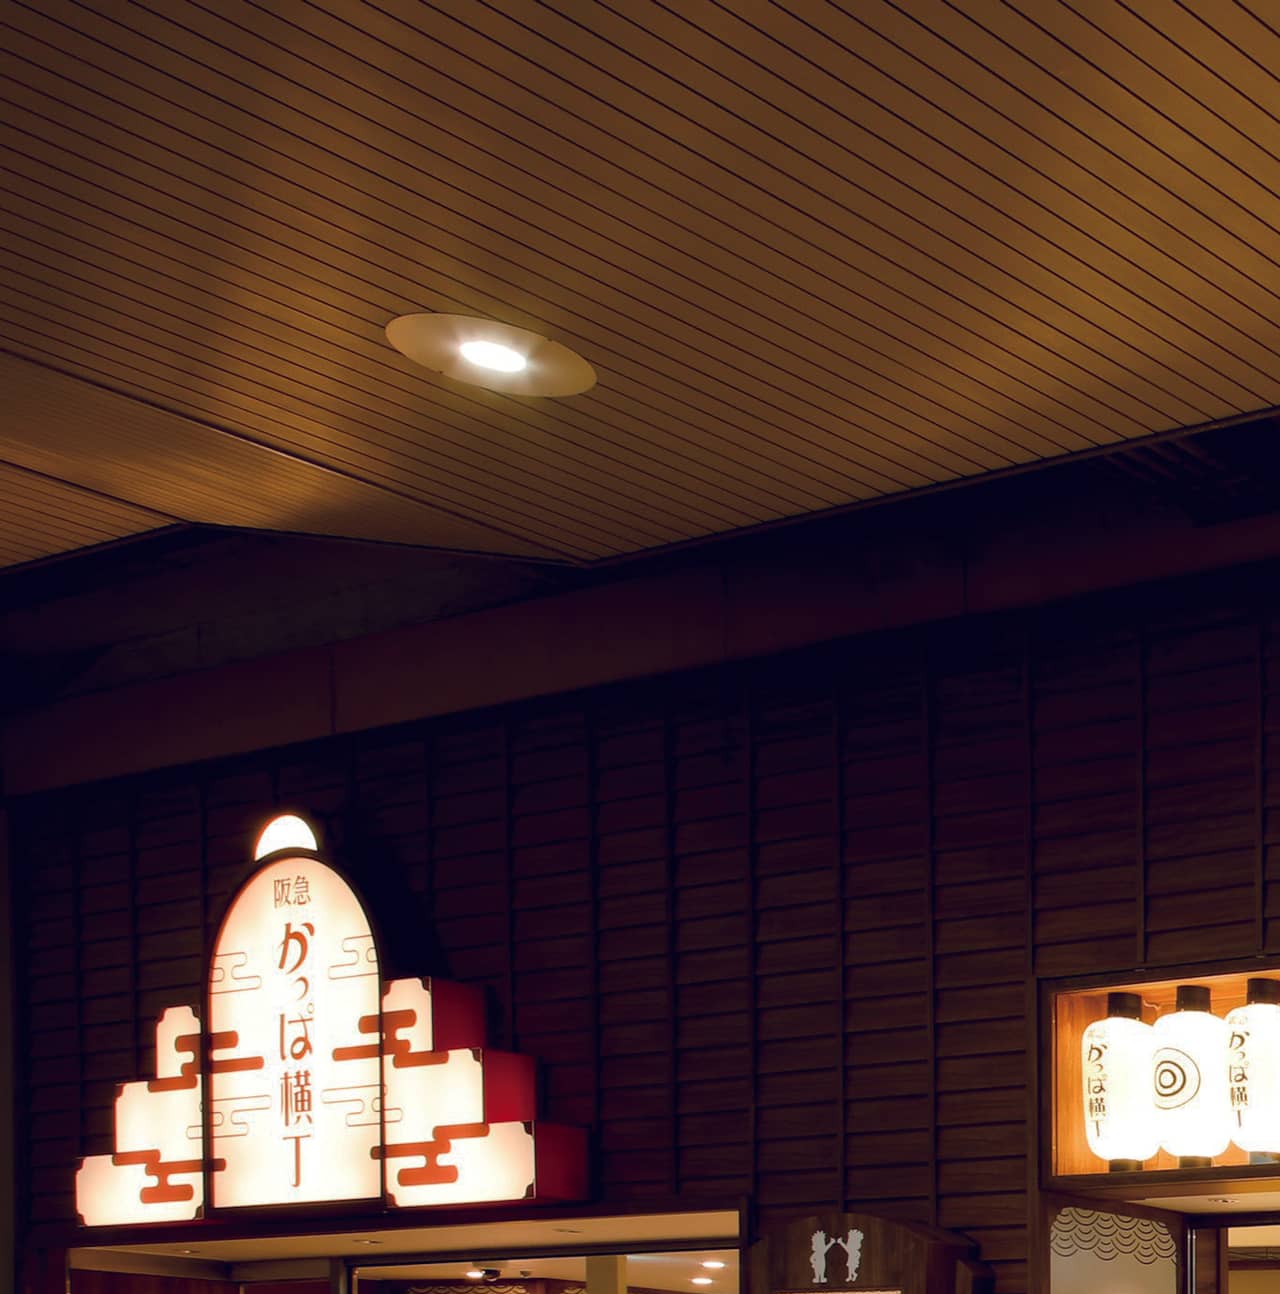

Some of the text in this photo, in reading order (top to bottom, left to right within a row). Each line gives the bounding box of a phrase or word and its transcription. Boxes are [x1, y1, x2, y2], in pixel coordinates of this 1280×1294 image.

[273, 874, 311, 909] 阪急
[277, 921, 315, 1188] かっぱ横丁
